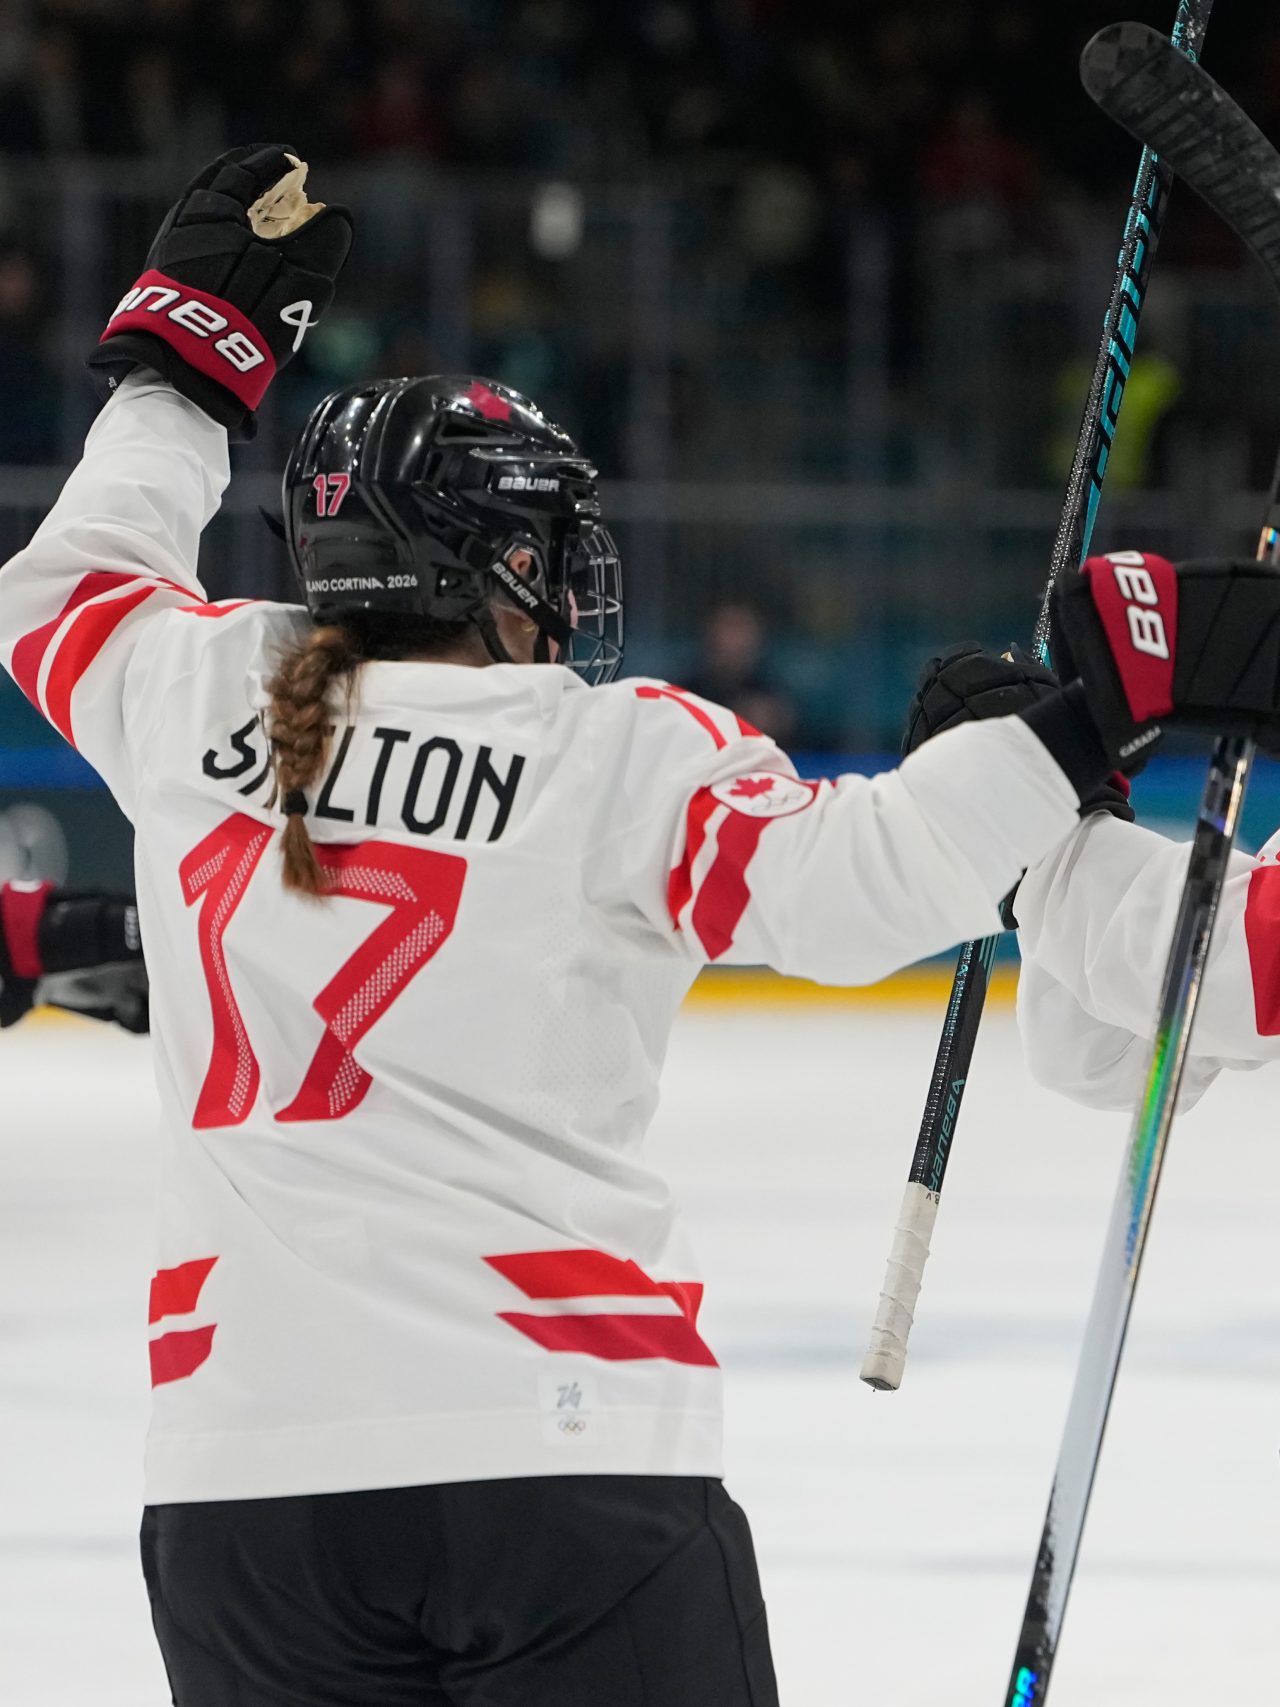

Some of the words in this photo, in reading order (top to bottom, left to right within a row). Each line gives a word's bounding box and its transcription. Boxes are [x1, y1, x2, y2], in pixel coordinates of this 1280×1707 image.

[313, 473, 350, 516] 17
[498, 476, 559, 492] BAUER
[330, 577, 385, 591] CORTINA
[387, 574, 418, 589] 2026
[492, 562, 539, 608] BAUER
[202, 714, 526, 843] SLTON
[179, 812, 467, 1129] 17
